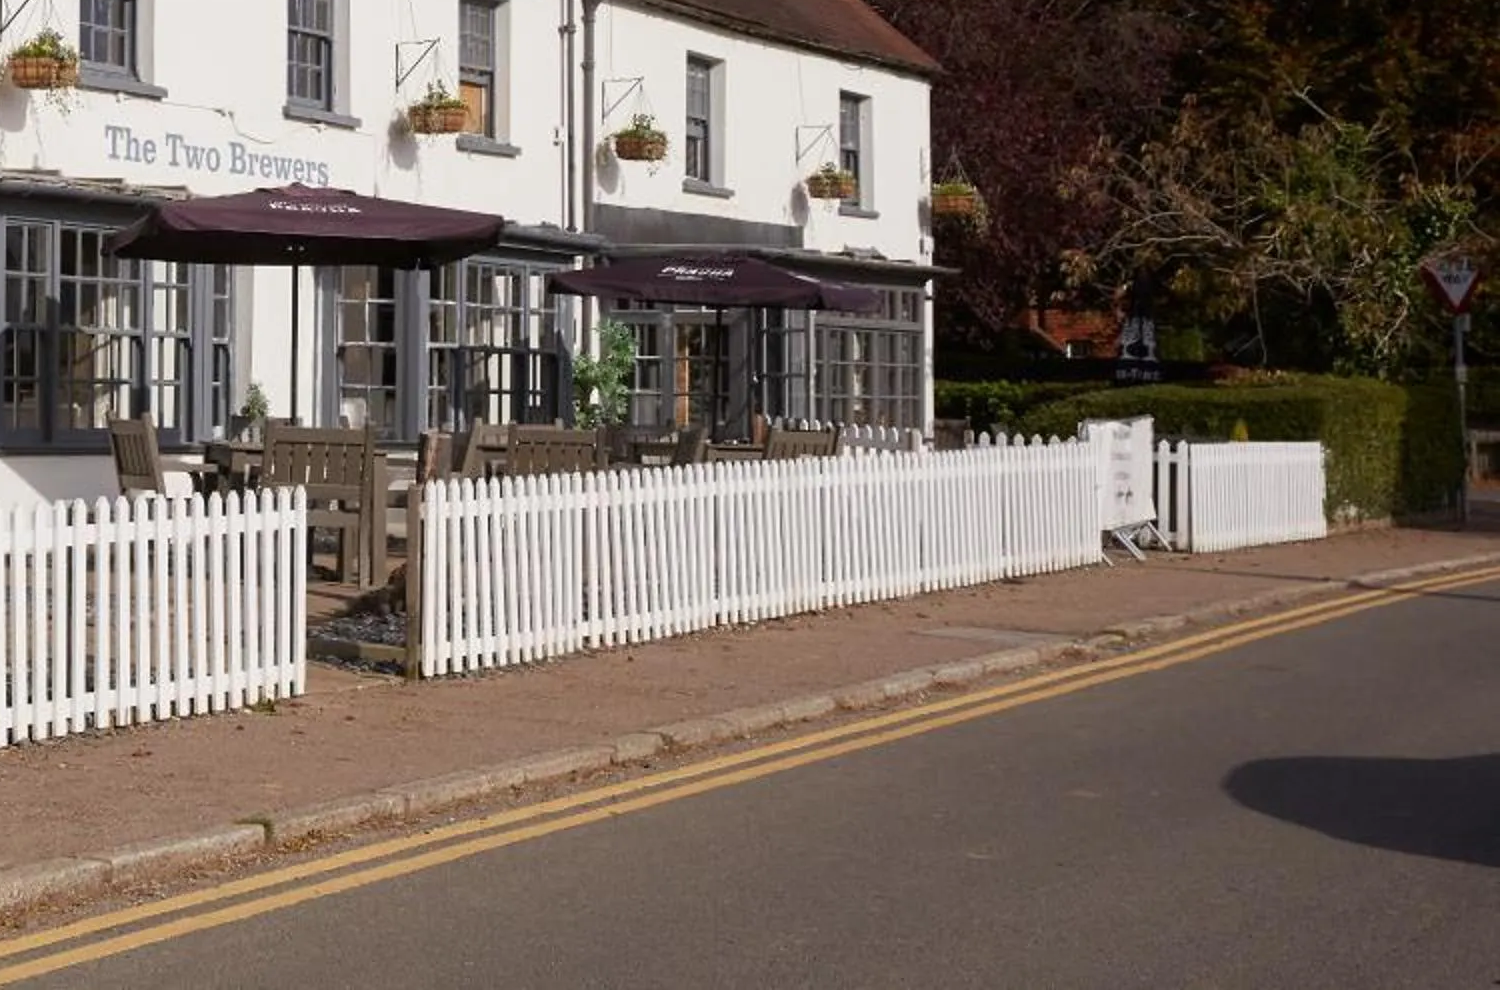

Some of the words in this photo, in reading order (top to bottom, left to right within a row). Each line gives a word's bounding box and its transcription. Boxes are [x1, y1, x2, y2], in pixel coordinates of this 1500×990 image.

[104, 124, 157, 165] The
[165, 132, 221, 173] Two
[228, 141, 330, 186] Brewers
